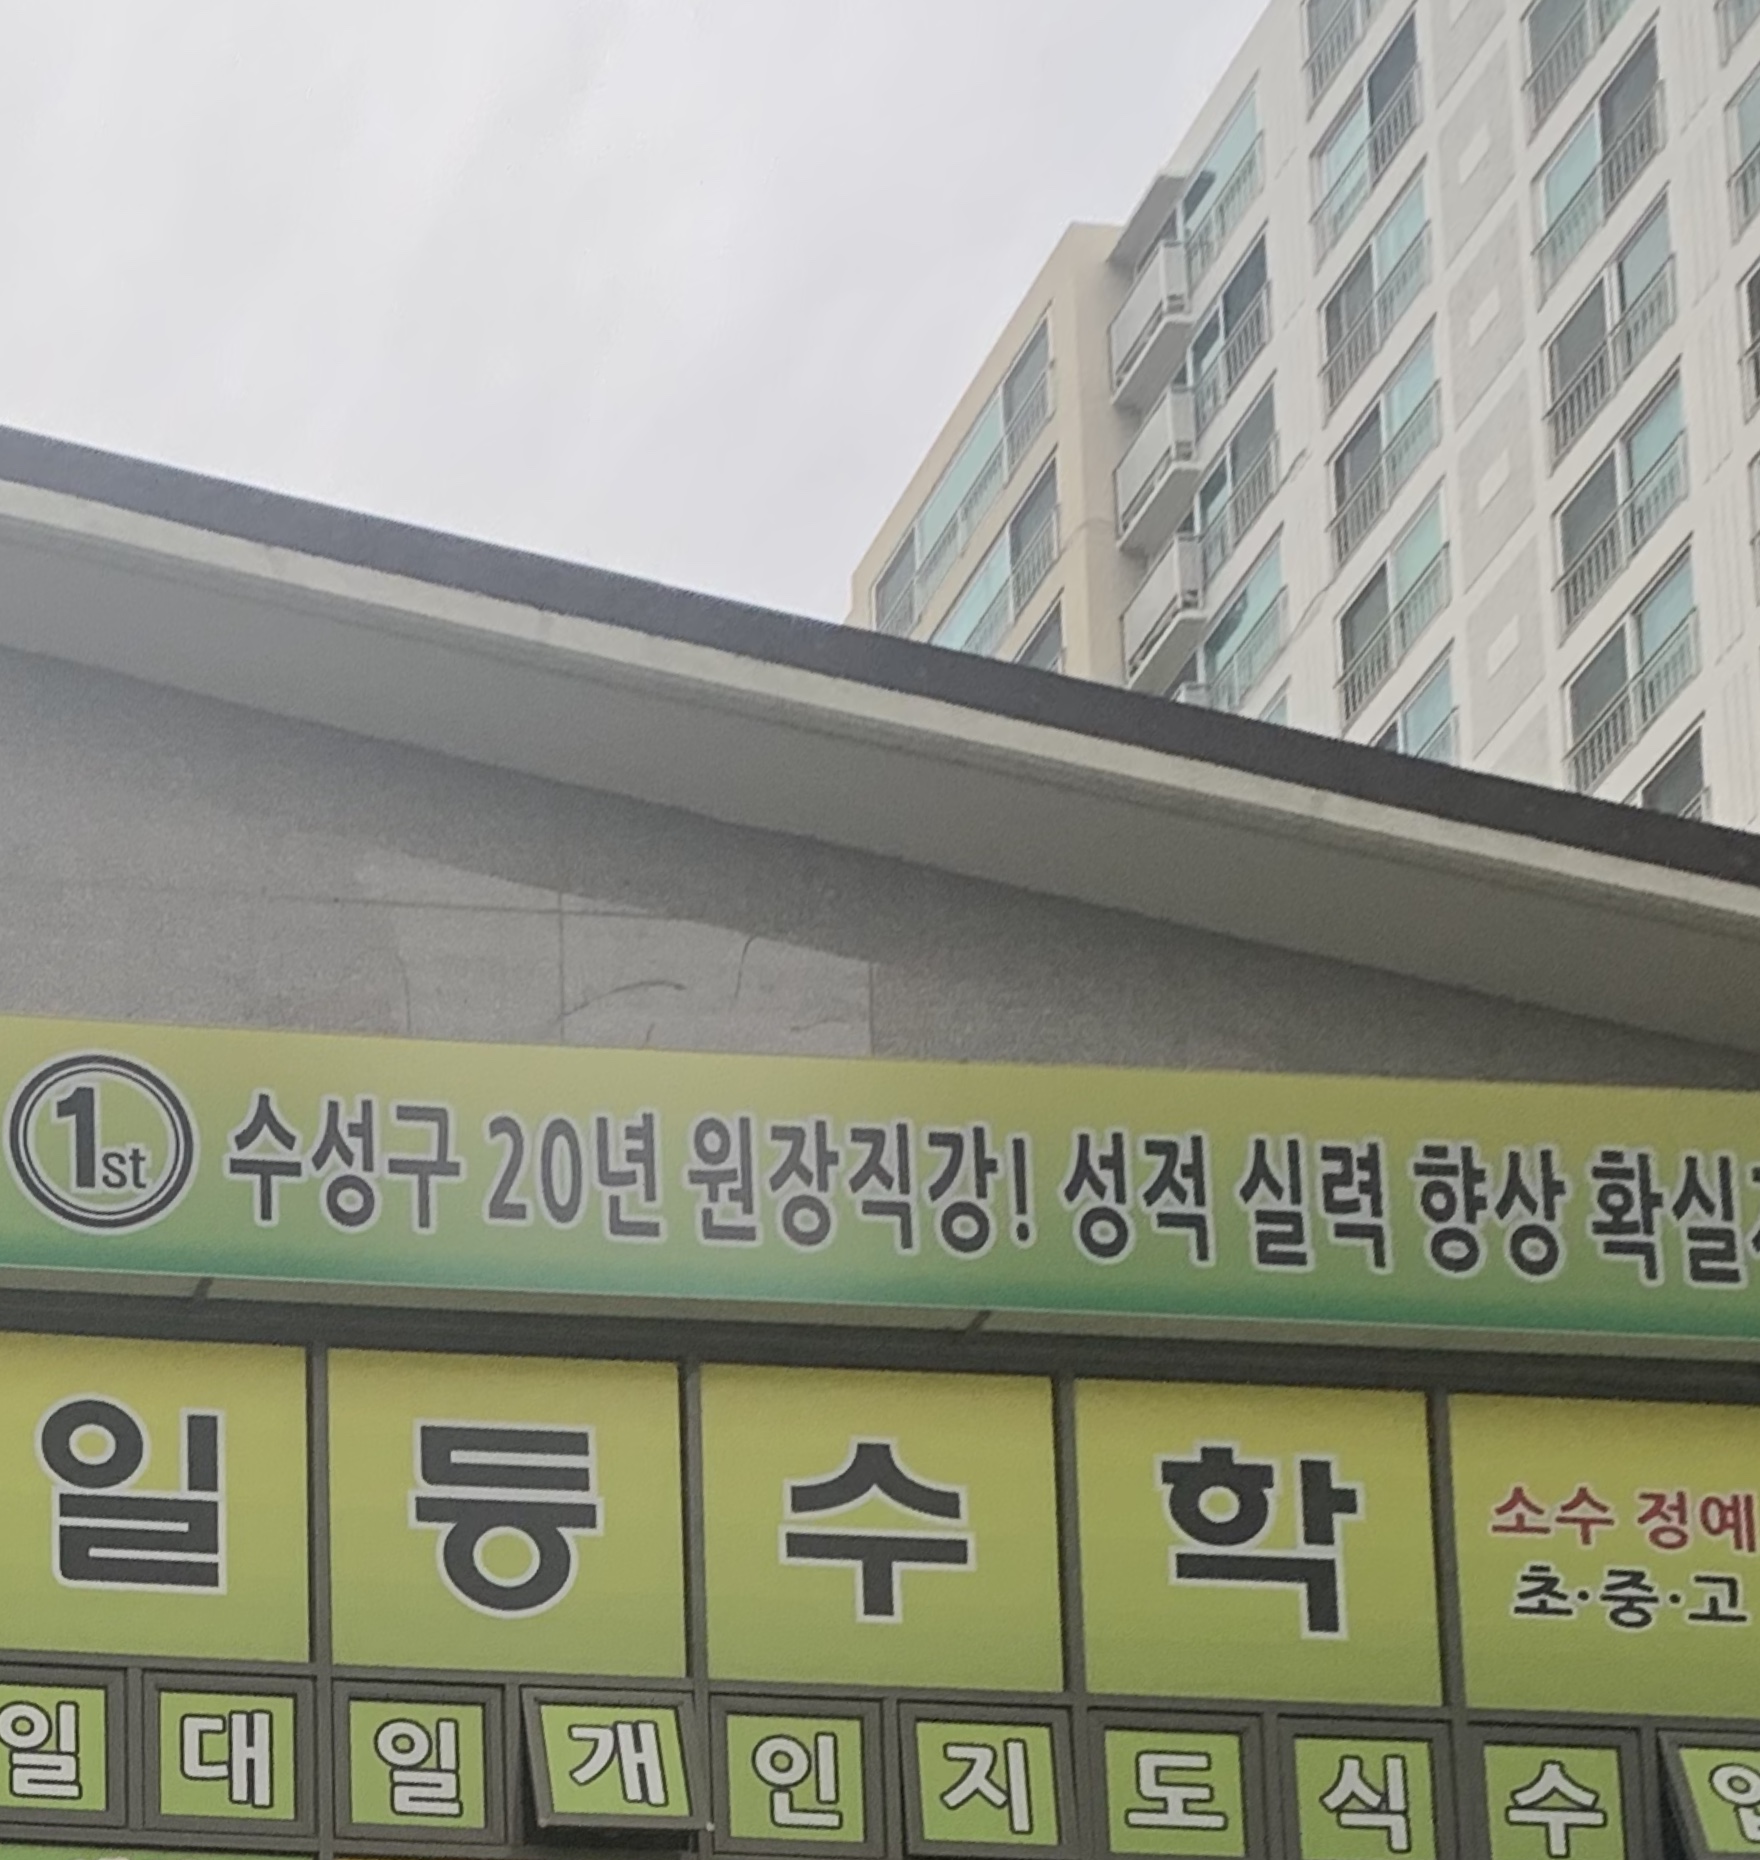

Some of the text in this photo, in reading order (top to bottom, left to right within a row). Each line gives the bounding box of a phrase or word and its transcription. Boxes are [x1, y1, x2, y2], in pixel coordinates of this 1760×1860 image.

[55, 1086, 151, 1193] 1st
[229, 1092, 460, 1230] 수성구
[486, 1111, 661, 1239] 20년
[1064, 1131, 1210, 1262] 성적
[1241, 1138, 1386, 1270] 실력
[1413, 1144, 1565, 1277] 향상
[1590, 1150, 1760, 1285] 확실
